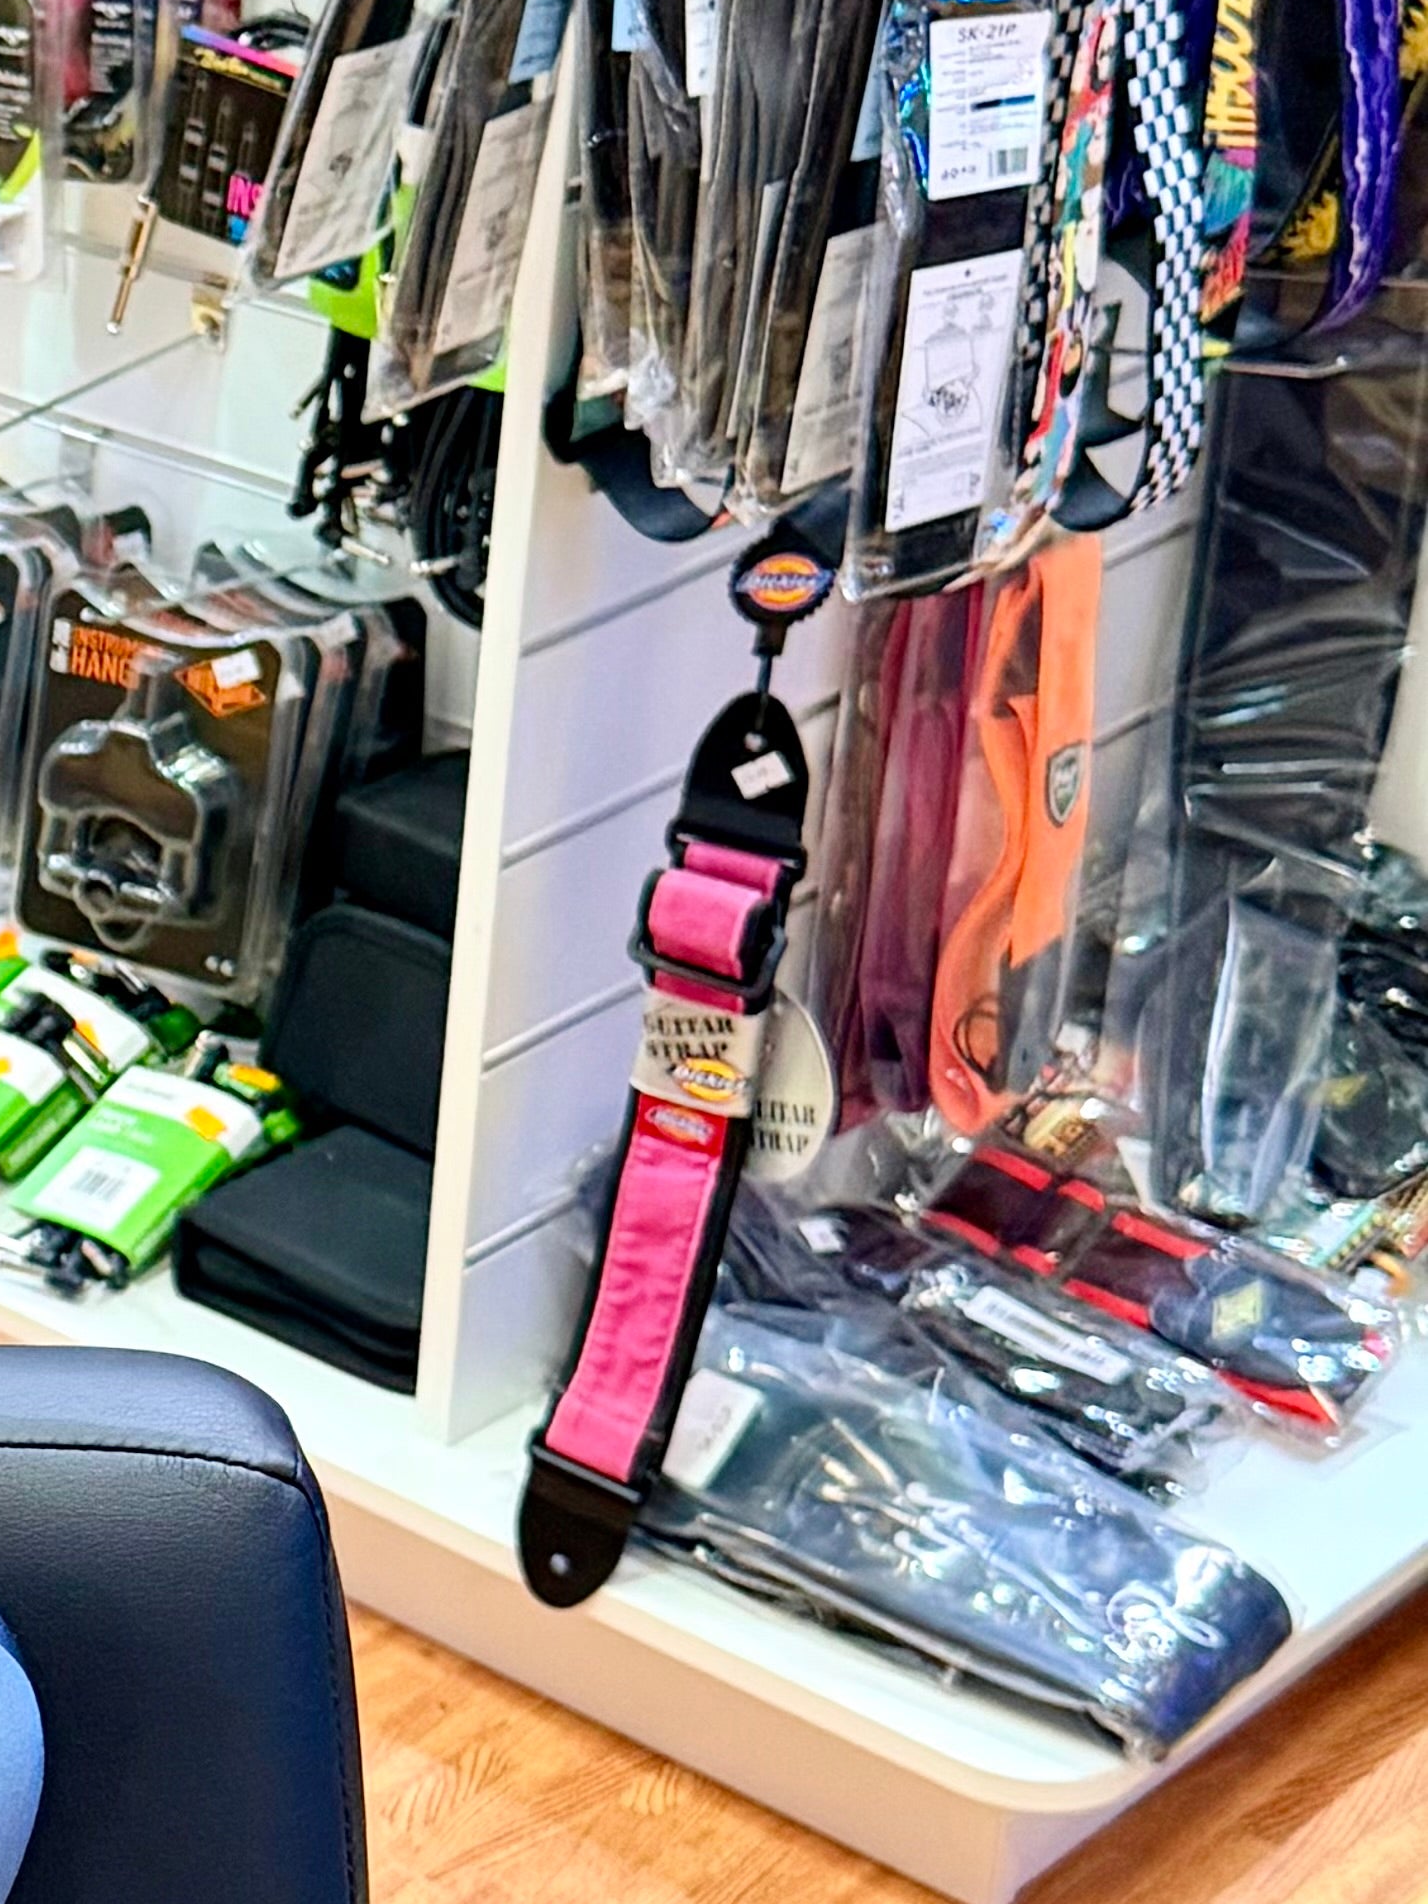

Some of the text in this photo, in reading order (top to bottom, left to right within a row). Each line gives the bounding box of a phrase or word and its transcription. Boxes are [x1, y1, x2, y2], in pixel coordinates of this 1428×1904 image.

[71, 645, 140, 691] HANG
[755, 1098, 816, 1126] UITAR
[756, 1129, 810, 1153] TRAP
